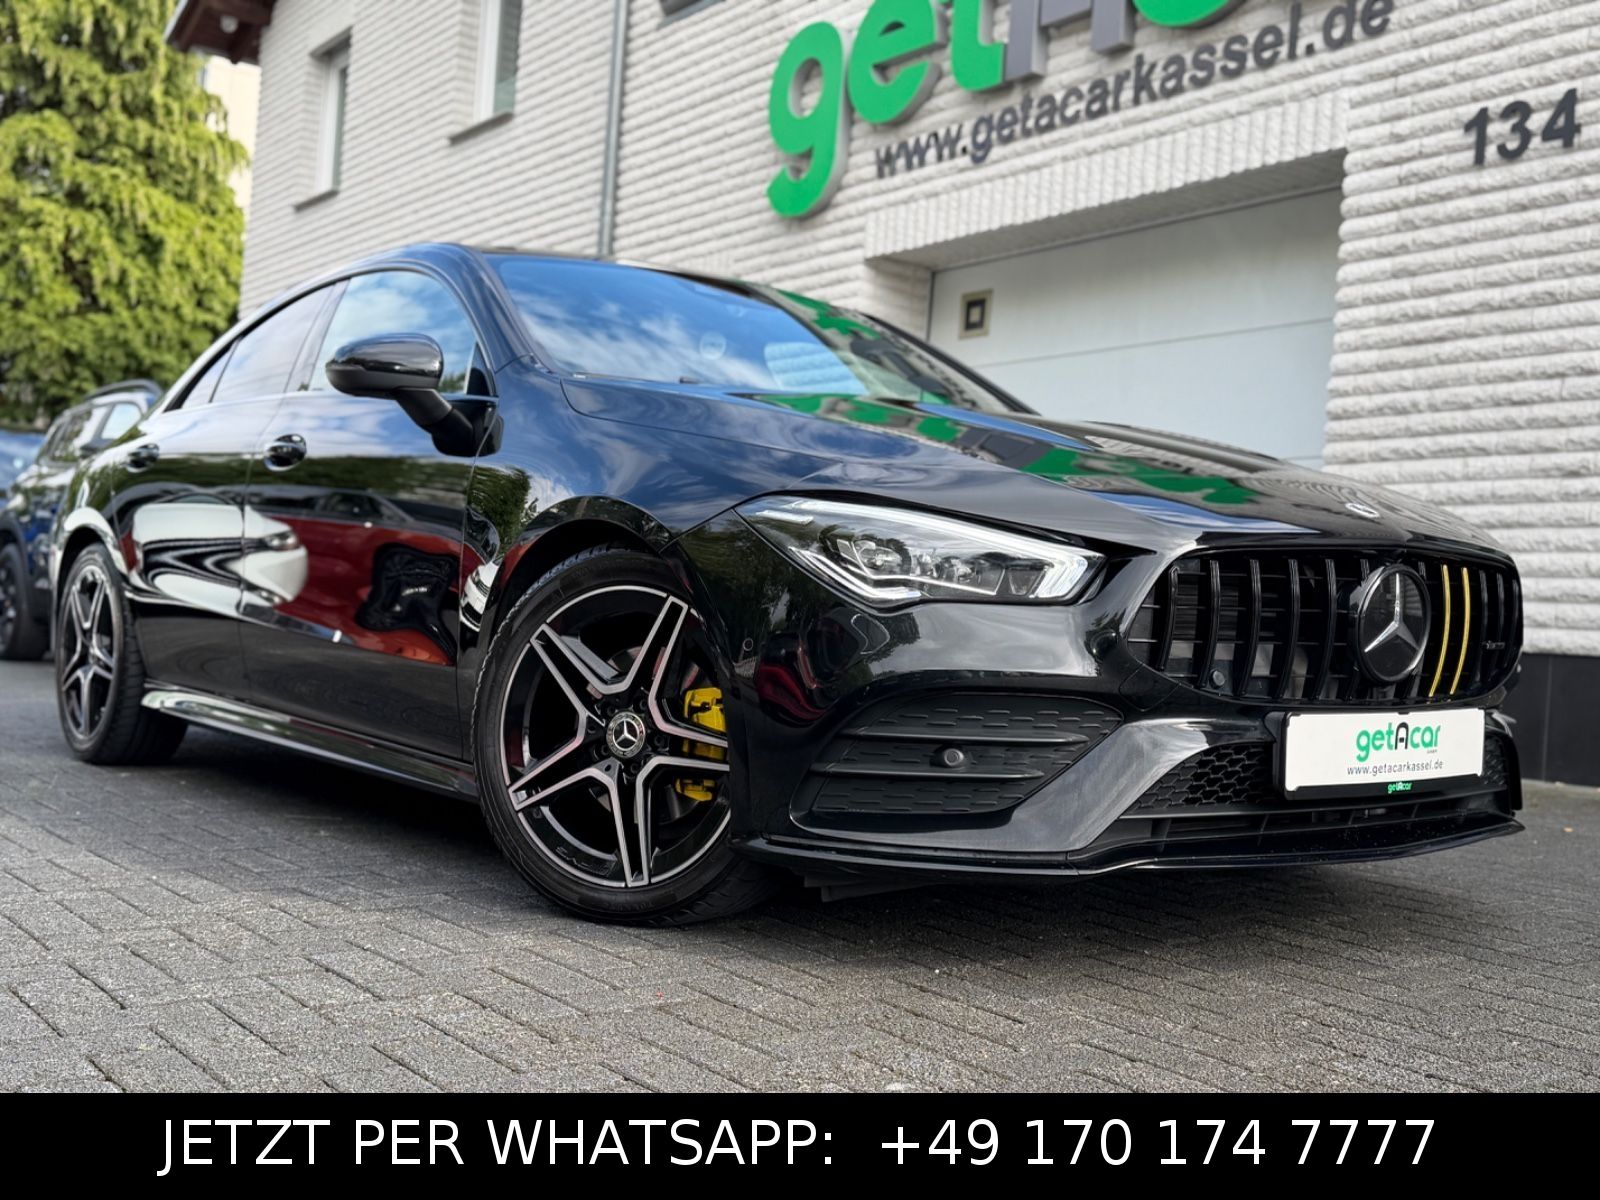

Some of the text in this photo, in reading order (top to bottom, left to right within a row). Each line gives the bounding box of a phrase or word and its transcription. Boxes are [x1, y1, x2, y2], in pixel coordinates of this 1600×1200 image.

[875, 0, 1394, 179] www.getacarkassel.de
[1464, 88, 1582, 170] 134
[1347, 760, 1443, 776] www.getacarkassel.de
